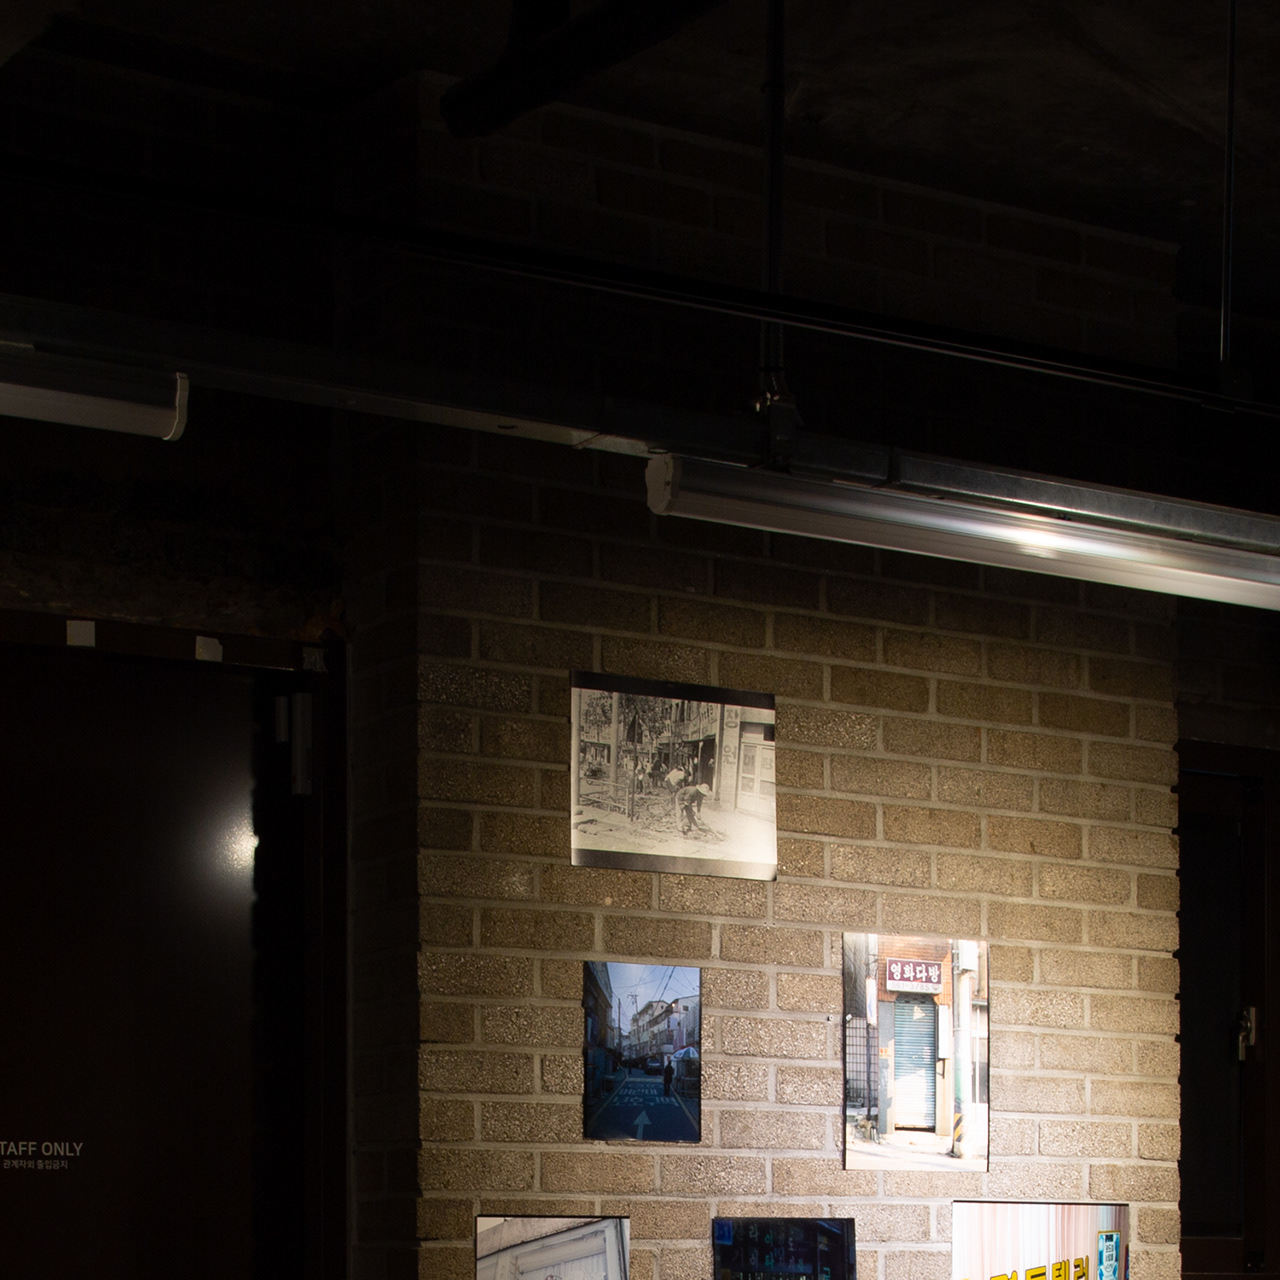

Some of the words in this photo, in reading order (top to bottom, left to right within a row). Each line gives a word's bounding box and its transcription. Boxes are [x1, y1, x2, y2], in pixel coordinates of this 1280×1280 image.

[890, 962, 940, 983] 영화다방
[41, 1141, 83, 1156] ONLY
[3, 1159, 35, 1169] 관계자외
[36, 1159, 68, 1170] 출입금지
